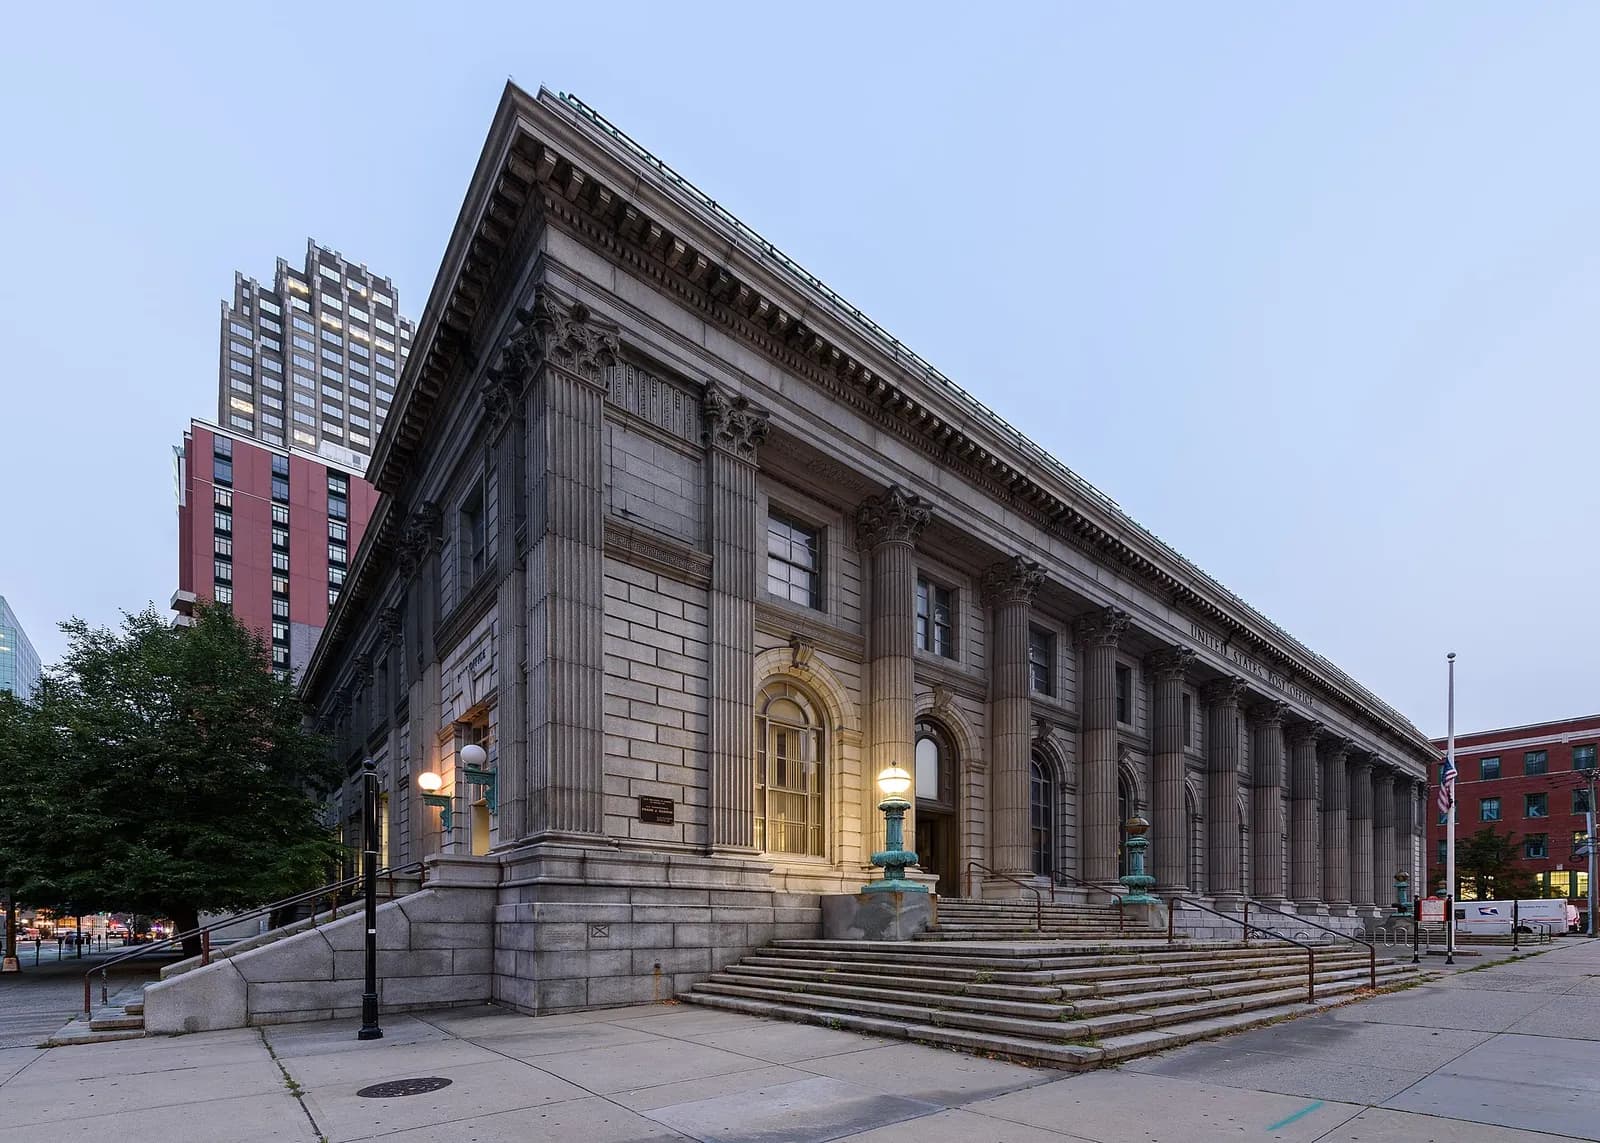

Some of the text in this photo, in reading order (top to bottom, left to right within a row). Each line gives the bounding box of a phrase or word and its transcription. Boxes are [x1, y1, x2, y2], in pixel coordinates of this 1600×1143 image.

[1191, 624, 1314, 708] UNITED STATES POST OFFICE
